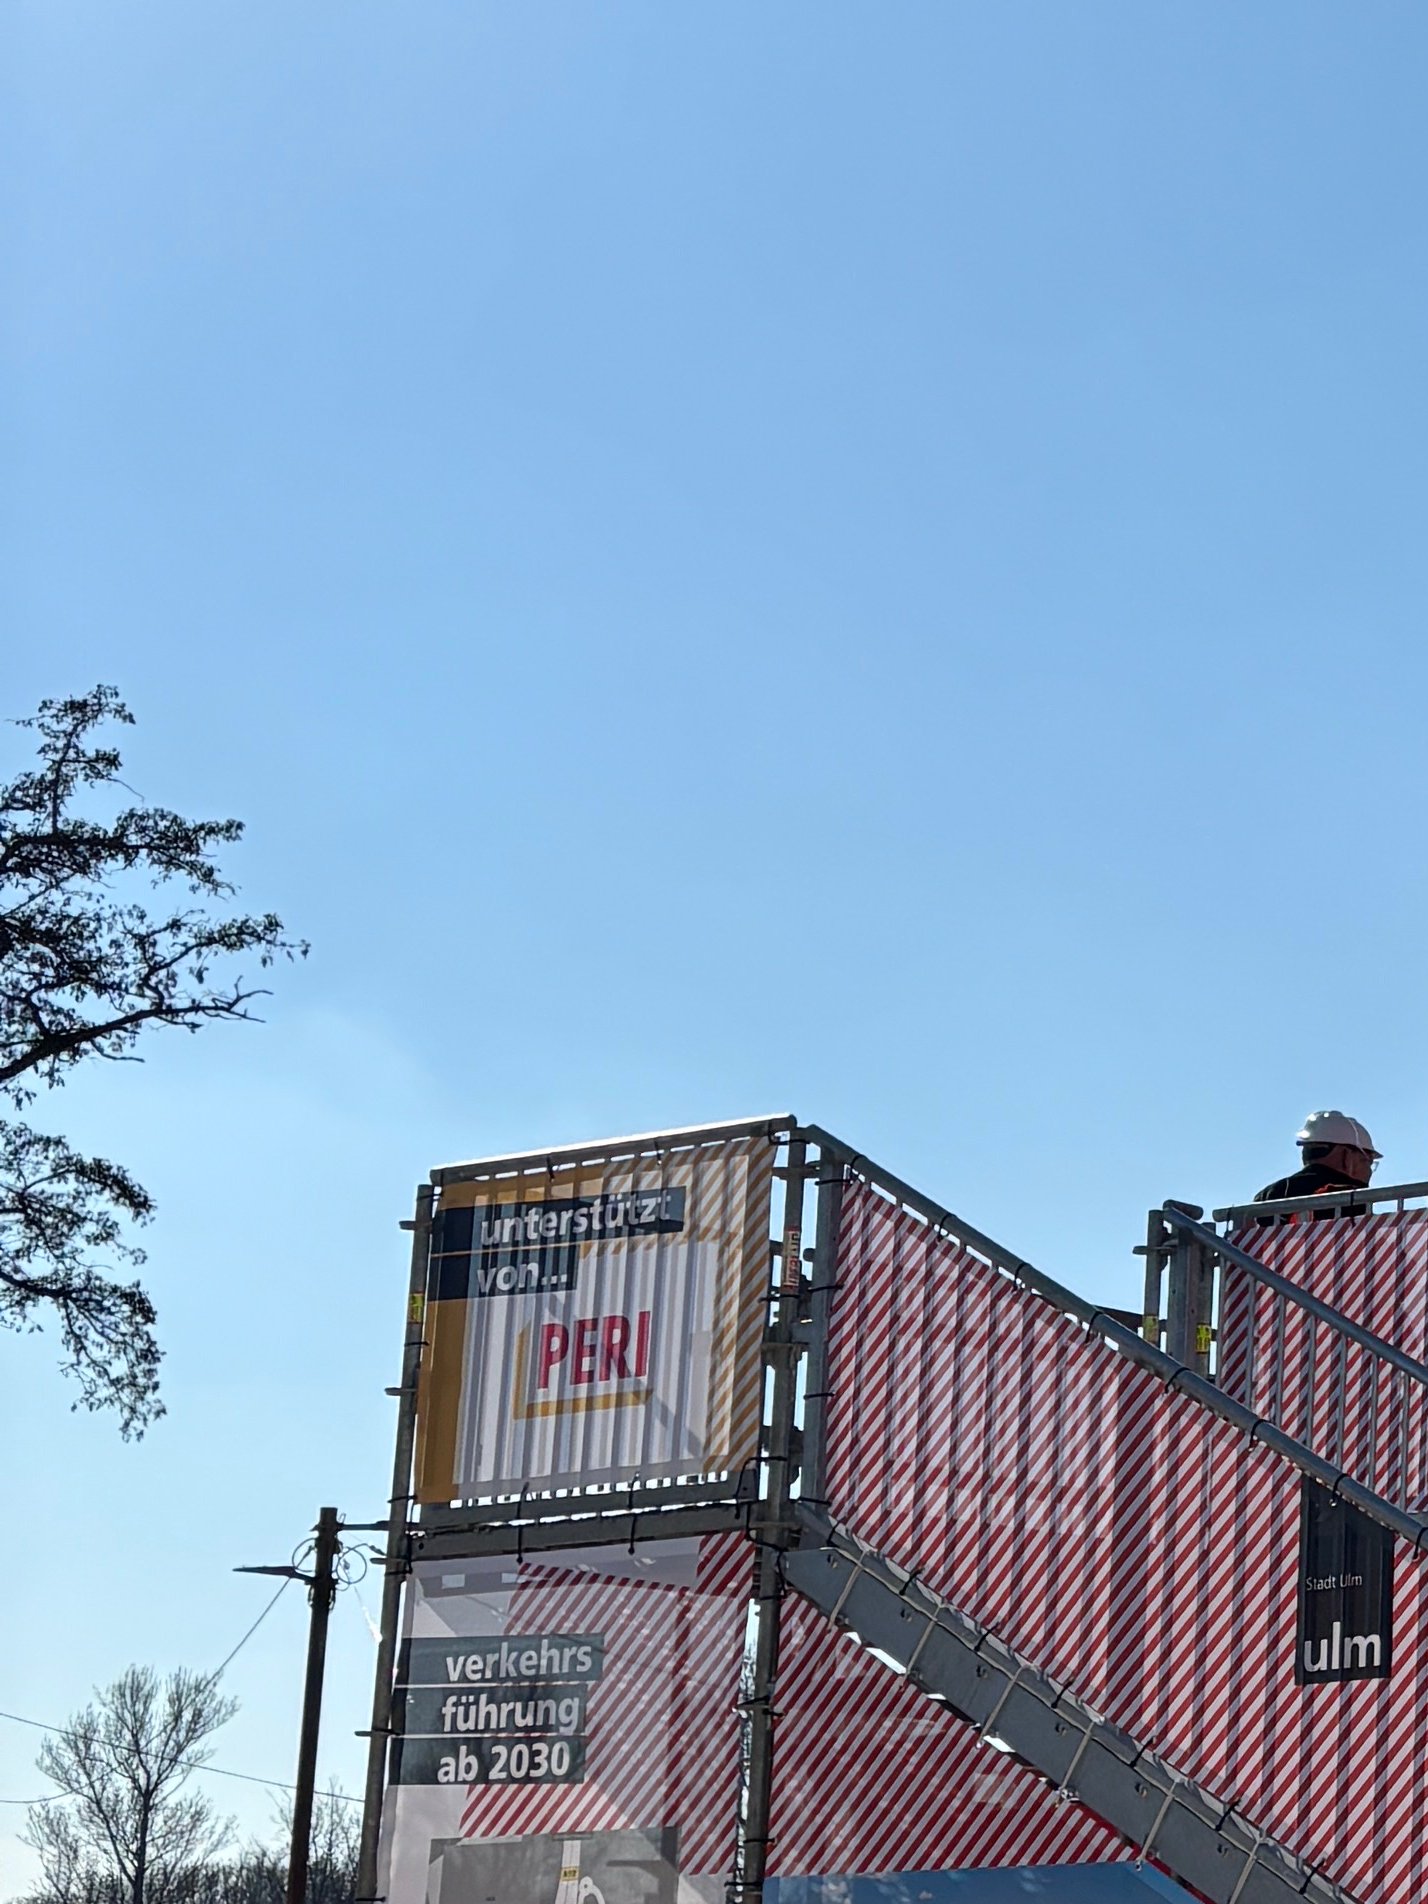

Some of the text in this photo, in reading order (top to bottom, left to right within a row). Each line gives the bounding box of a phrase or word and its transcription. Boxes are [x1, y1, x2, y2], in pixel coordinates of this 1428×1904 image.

[481, 1190, 672, 1246] unterstützt
[477, 1261, 568, 1293] von...
[537, 1310, 651, 1390] PERI
[1305, 1573, 1363, 1591] Stadt Ulm
[446, 1639, 593, 1682] verkehrs
[1304, 1621, 1381, 1672] ulm
[442, 1693, 580, 1736] führung
[437, 1741, 571, 1784] ab 2030
